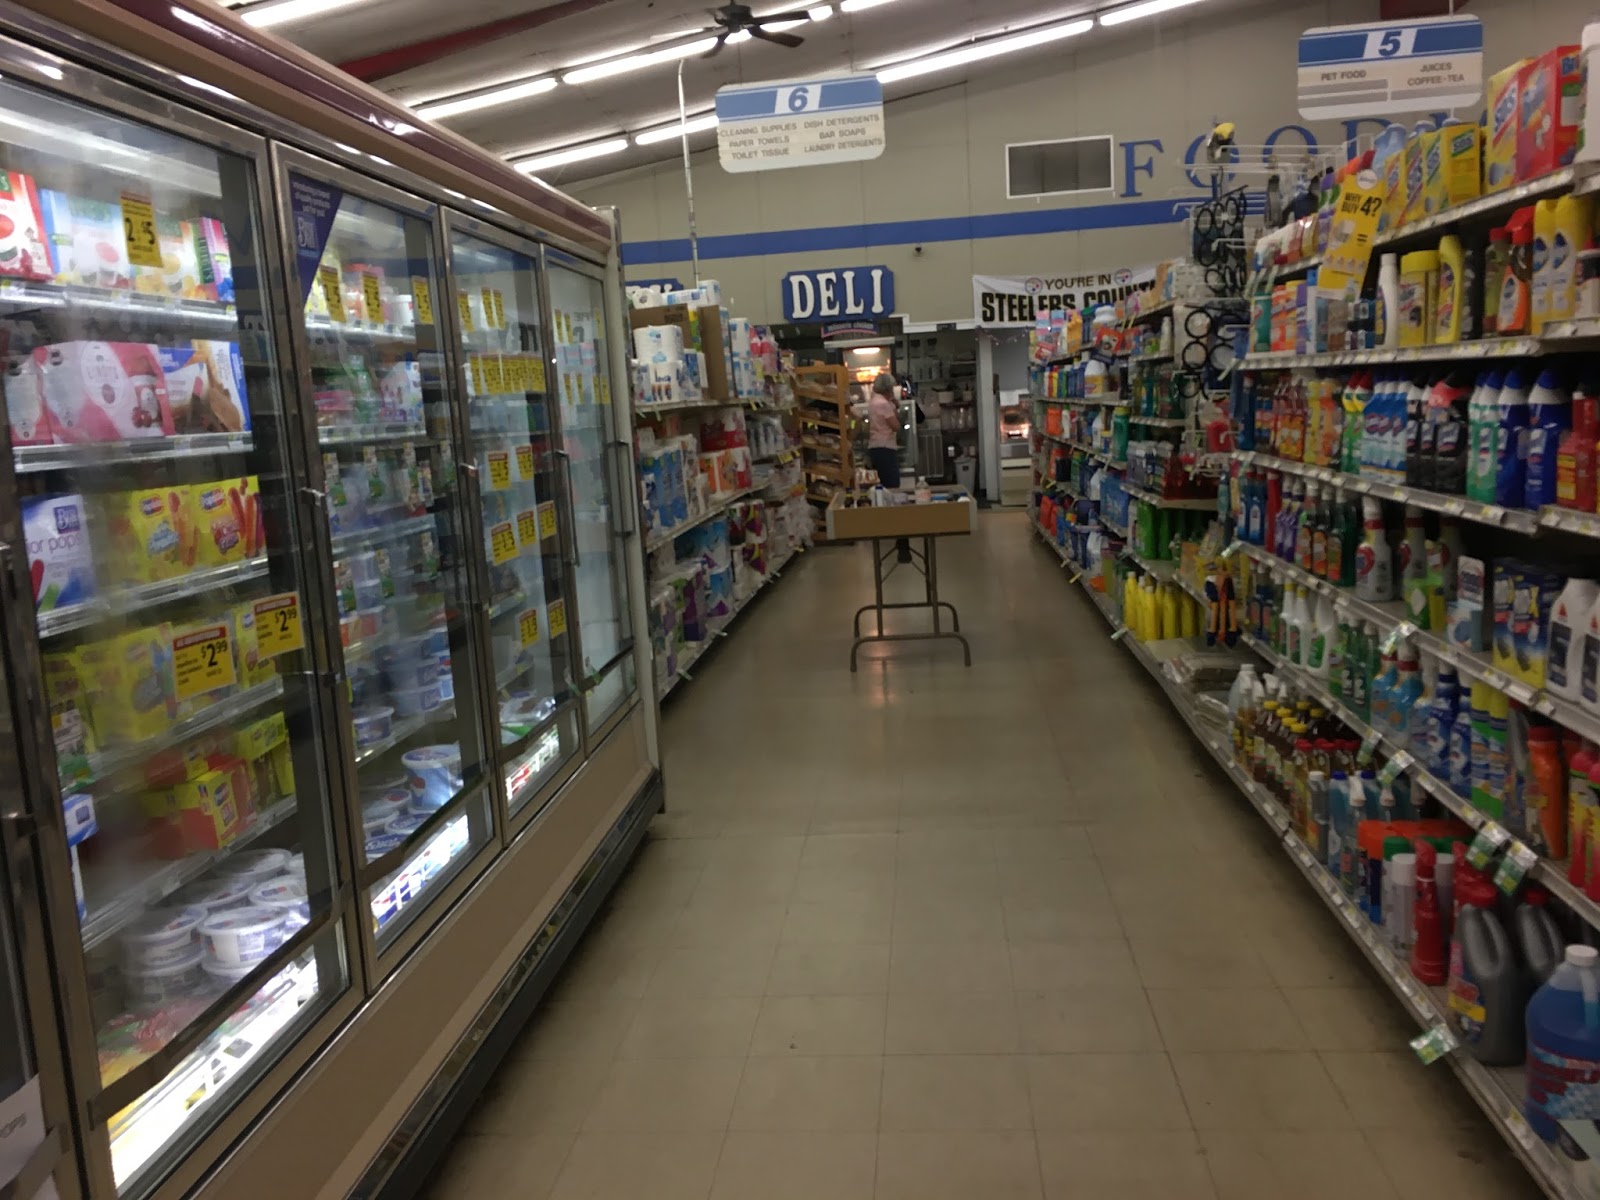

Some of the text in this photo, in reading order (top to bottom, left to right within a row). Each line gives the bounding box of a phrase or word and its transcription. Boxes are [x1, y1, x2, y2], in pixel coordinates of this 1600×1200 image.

[1377, 30, 1402, 57] 5
[1320, 69, 1367, 82] PET FOOD
[1419, 62, 1453, 73] JUICES
[787, 86, 809, 113] 6
[803, 113, 880, 130] DISH DETERGENTS
[720, 122, 798, 138] CLEANING SUPPLIES
[818, 127, 867, 141] BAR SOAPS
[728, 135, 790, 149] PAPER TOWELS
[803, 138, 883, 154] LAUNDRY DETERGENTS
[731, 147, 791, 161] TOILET TISSUE
[1044, 273, 1112, 291] YOU'RE IN
[789, 268, 884, 319] DELI
[981, 291, 1076, 323] STEELERS
